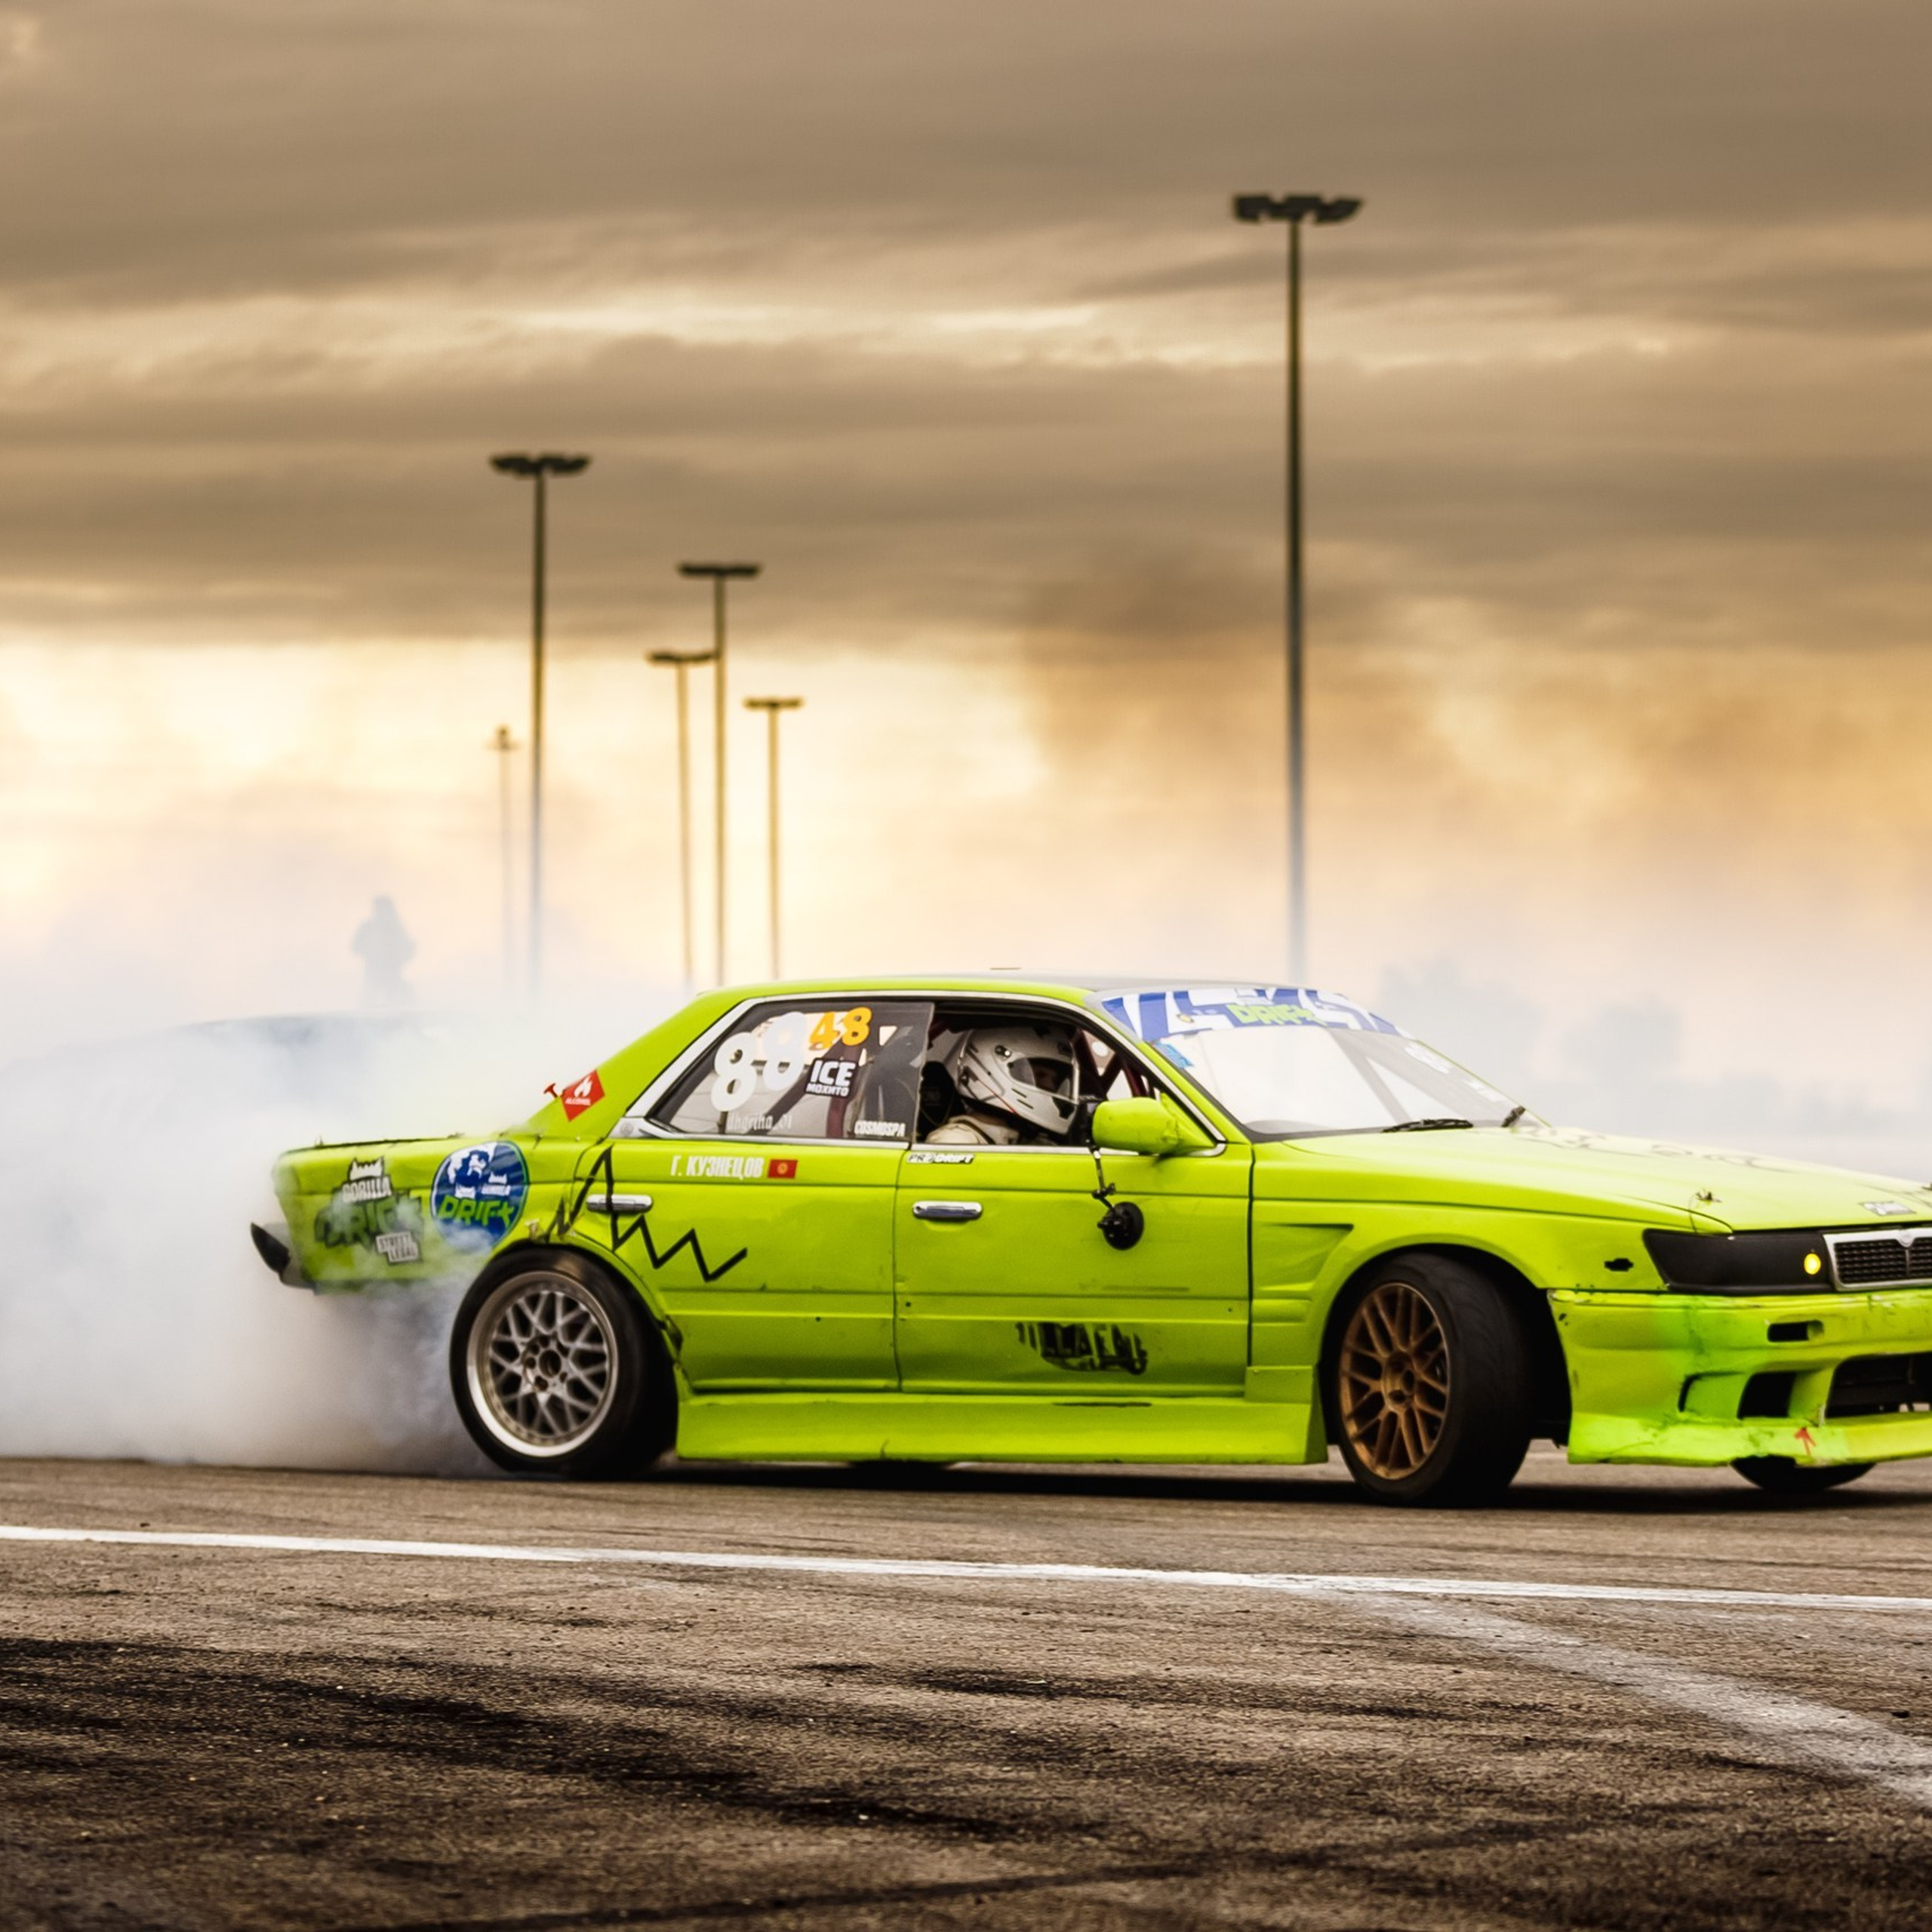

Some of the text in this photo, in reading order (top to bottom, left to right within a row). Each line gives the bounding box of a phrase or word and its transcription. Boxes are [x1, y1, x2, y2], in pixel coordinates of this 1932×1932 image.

[809, 1008, 872, 1050] 48
[810, 1060, 856, 1087] ICE
[671, 1155, 764, 1180] Г. КУЗНЕЦОВ
[342, 1177, 392, 1202] GORILLA
[437, 1195, 514, 1226] DRIFT
